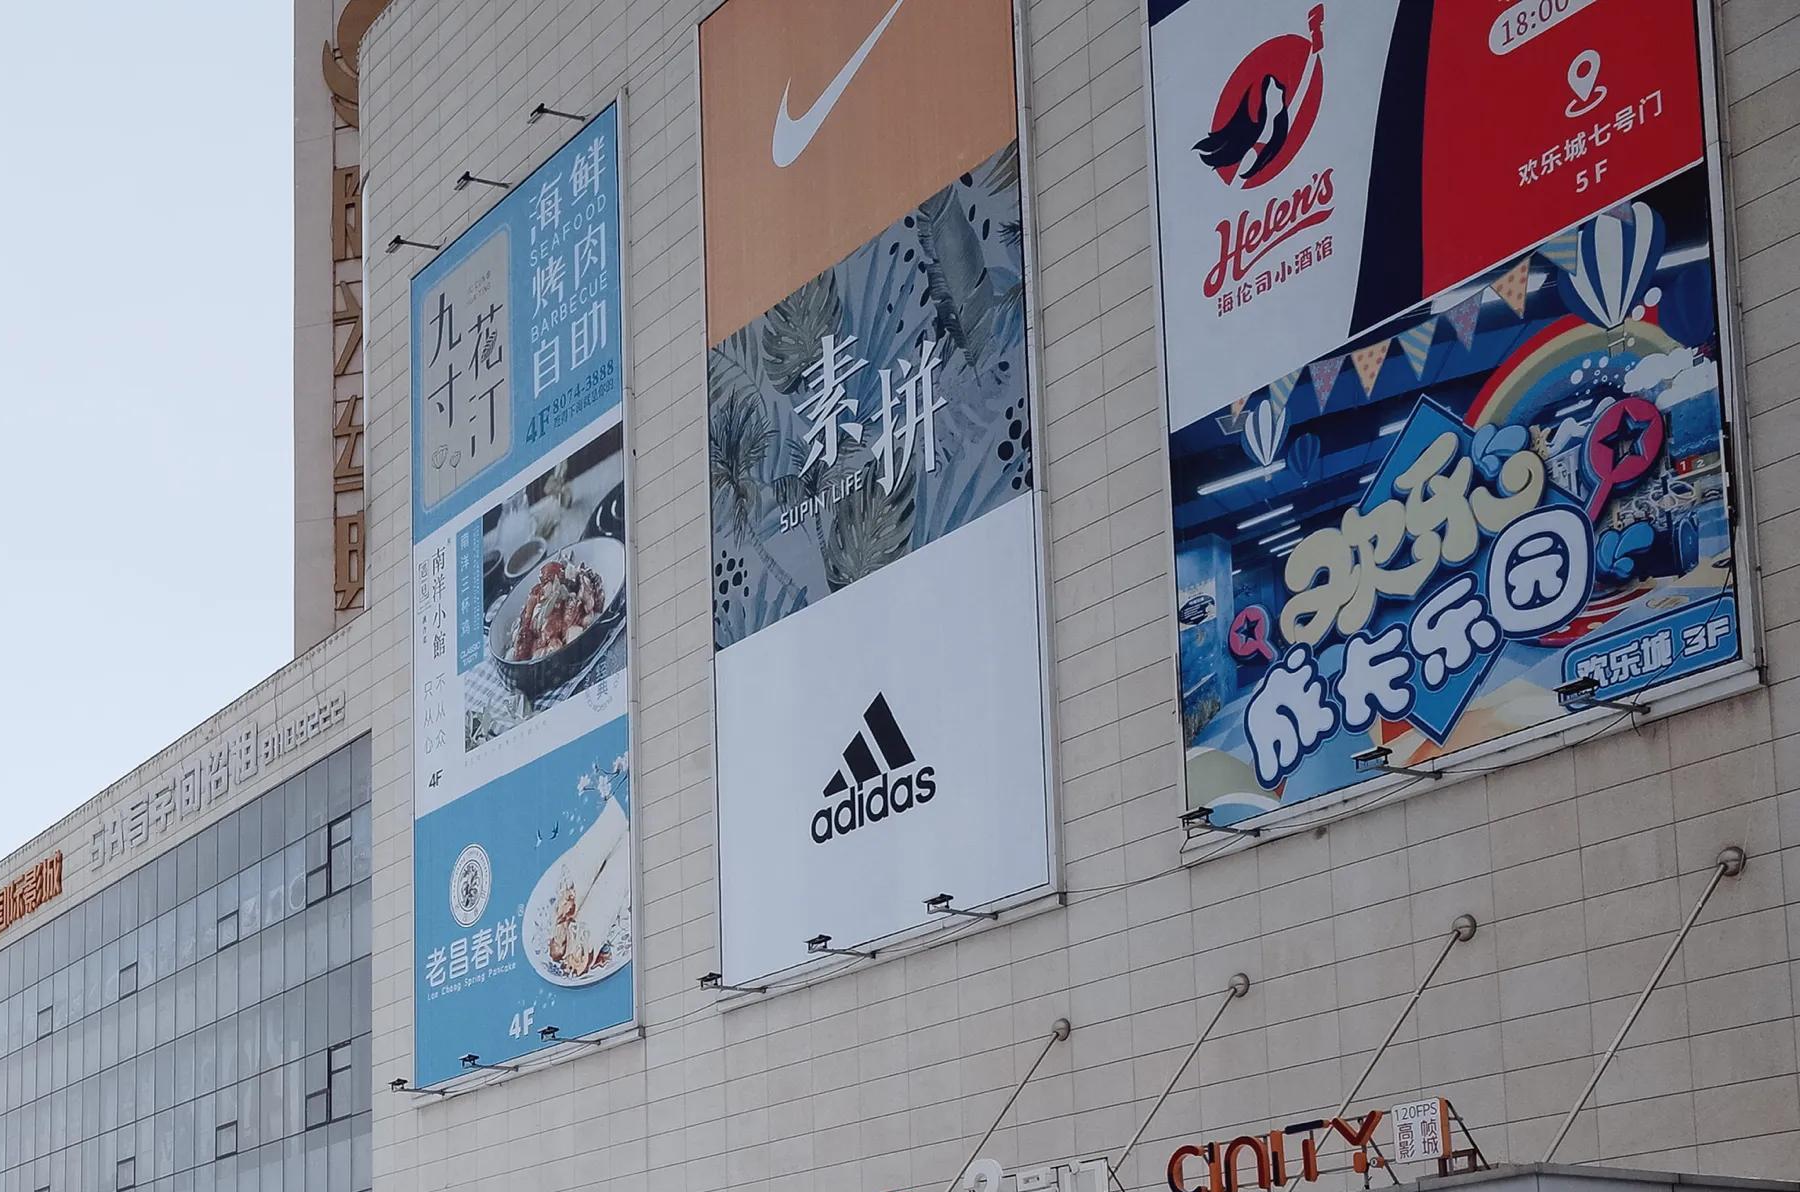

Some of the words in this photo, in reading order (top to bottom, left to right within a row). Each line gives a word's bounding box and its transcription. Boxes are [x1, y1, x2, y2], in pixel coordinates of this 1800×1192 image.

[1518, 90, 1662, 186] 欢乐城七号门
[529, 136, 606, 245] 海鲜
[529, 194, 607, 267] SEAFOOD
[532, 221, 606, 320] 烤肉
[1203, 168, 1334, 298] Helen's
[531, 270, 608, 344] BARBECUE
[1218, 236, 1333, 318] 海伦司小酒馆
[533, 299, 608, 400] 自助
[526, 405, 551, 443] 4F
[552, 359, 614, 415] 8074-3888
[793, 334, 949, 496] 素拼
[779, 492, 826, 534] SUPIN
[832, 470, 863, 502] LIFE
[431, 546, 447, 660] 南洋小館
[1576, 628, 1674, 688] 欢乐城
[1682, 616, 1730, 656] 3F
[428, 769, 444, 788] 4F
[811, 766, 937, 845] adidas
[425, 916, 518, 988] 老昌春饼
[509, 1006, 535, 1039] 4F
[1394, 1102, 1437, 1121] 120FPS
